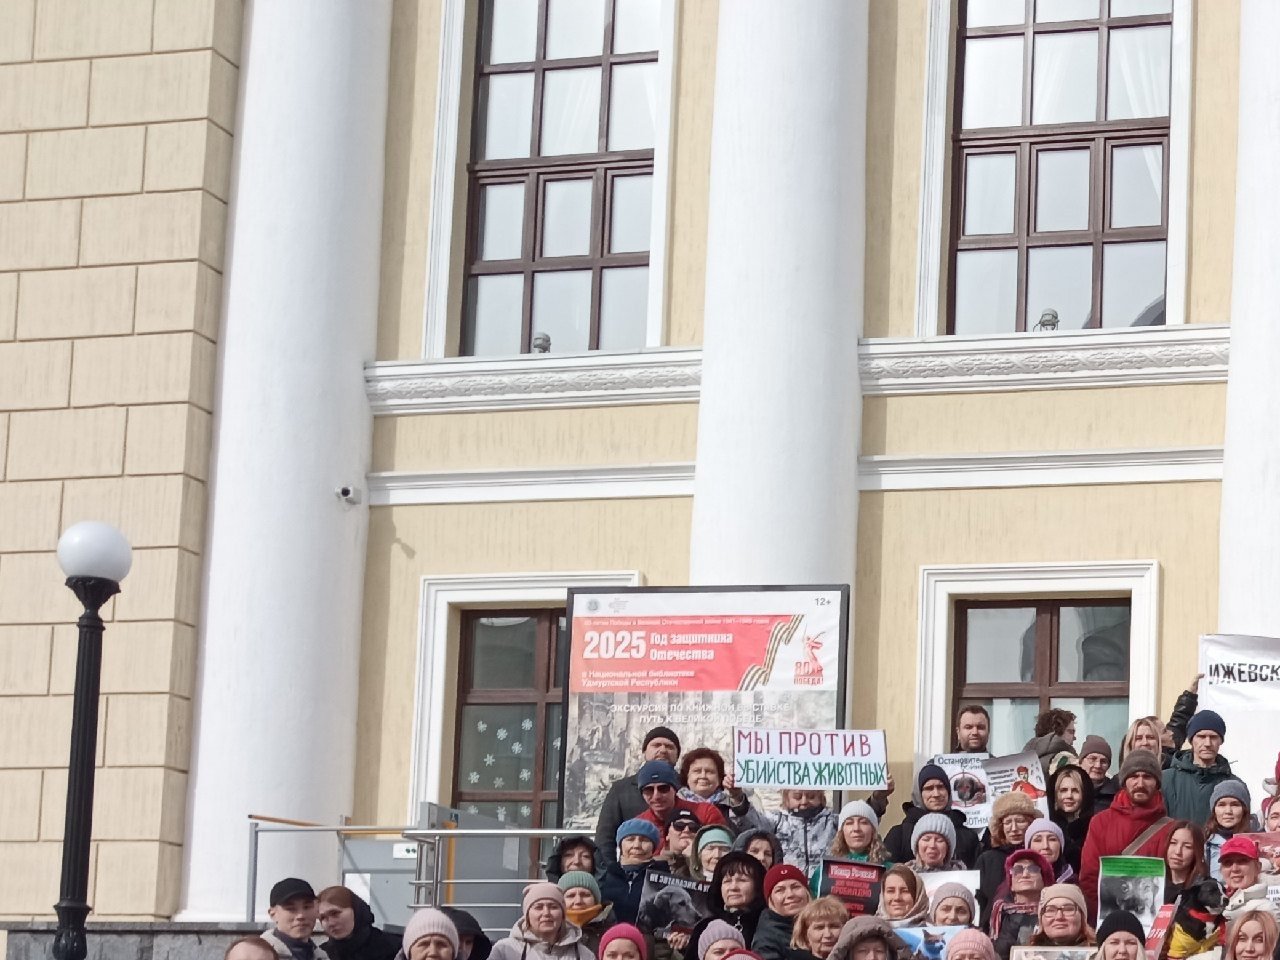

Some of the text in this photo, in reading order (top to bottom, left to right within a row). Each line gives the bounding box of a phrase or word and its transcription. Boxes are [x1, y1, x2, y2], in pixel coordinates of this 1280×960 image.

[814, 598, 832, 606] 12+
[582, 630, 733, 659] 2025 Год защитника
[650, 648, 714, 661] Отечества
[1208, 663, 1280, 684] ИЖЕВСК
[737, 730, 872, 757] МЫ ПРОТИВ
[736, 756, 888, 786] УБИЙСТВА ЖИВОТНЫХ
[938, 756, 980, 765] Остановите
